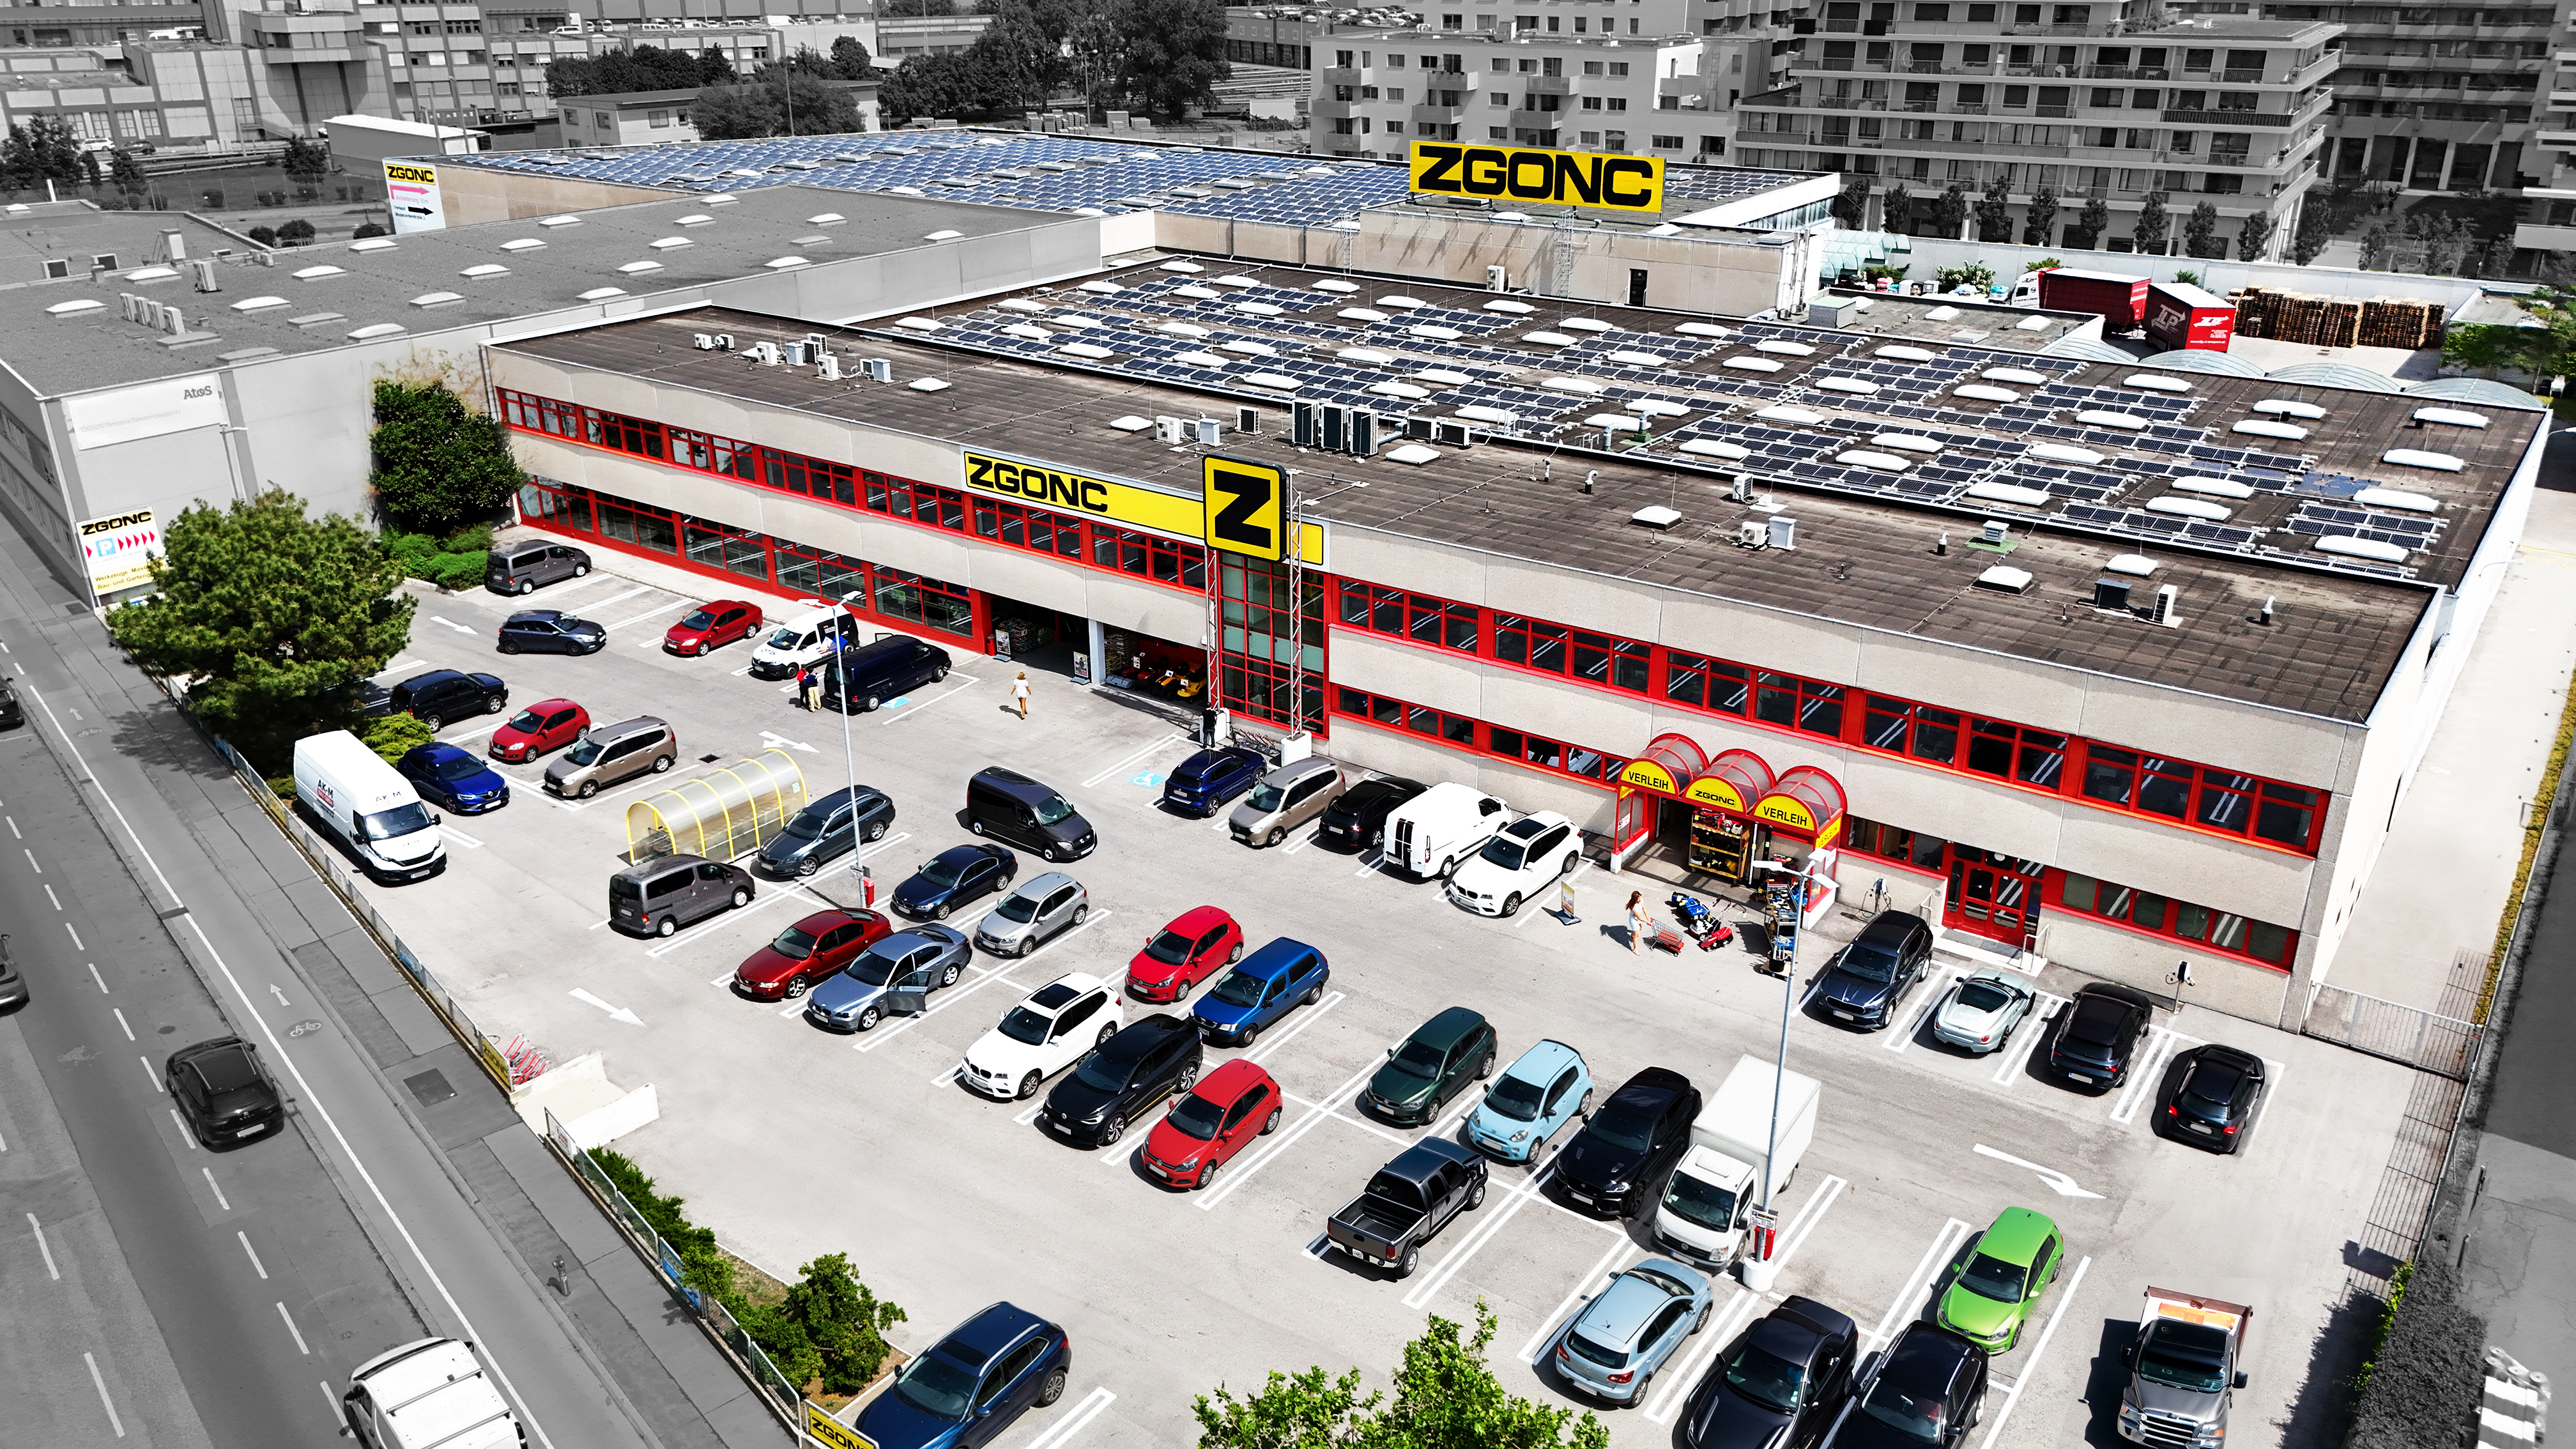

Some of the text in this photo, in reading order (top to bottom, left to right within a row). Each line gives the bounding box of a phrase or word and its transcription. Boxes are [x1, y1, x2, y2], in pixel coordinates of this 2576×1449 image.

[387, 165, 434, 183] ZGONC
[1418, 145, 1653, 207] ZGONC
[183, 385, 213, 400] Atos
[968, 456, 1108, 512] ZGONC
[1213, 469, 1271, 549] Z
[81, 511, 152, 535] ZGONC
[95, 571, 128, 582] Werkzeuge
[761, 648, 778, 656] OTIS
[318, 779, 334, 799] AK-M
[1629, 770, 1669, 790] VERLEIH
[376, 792, 401, 802] AK-M
[1695, 790, 1735, 806] ZGONC
[1763, 806, 1807, 827] VERLEIH
[812, 1416, 866, 1449] ZGON
